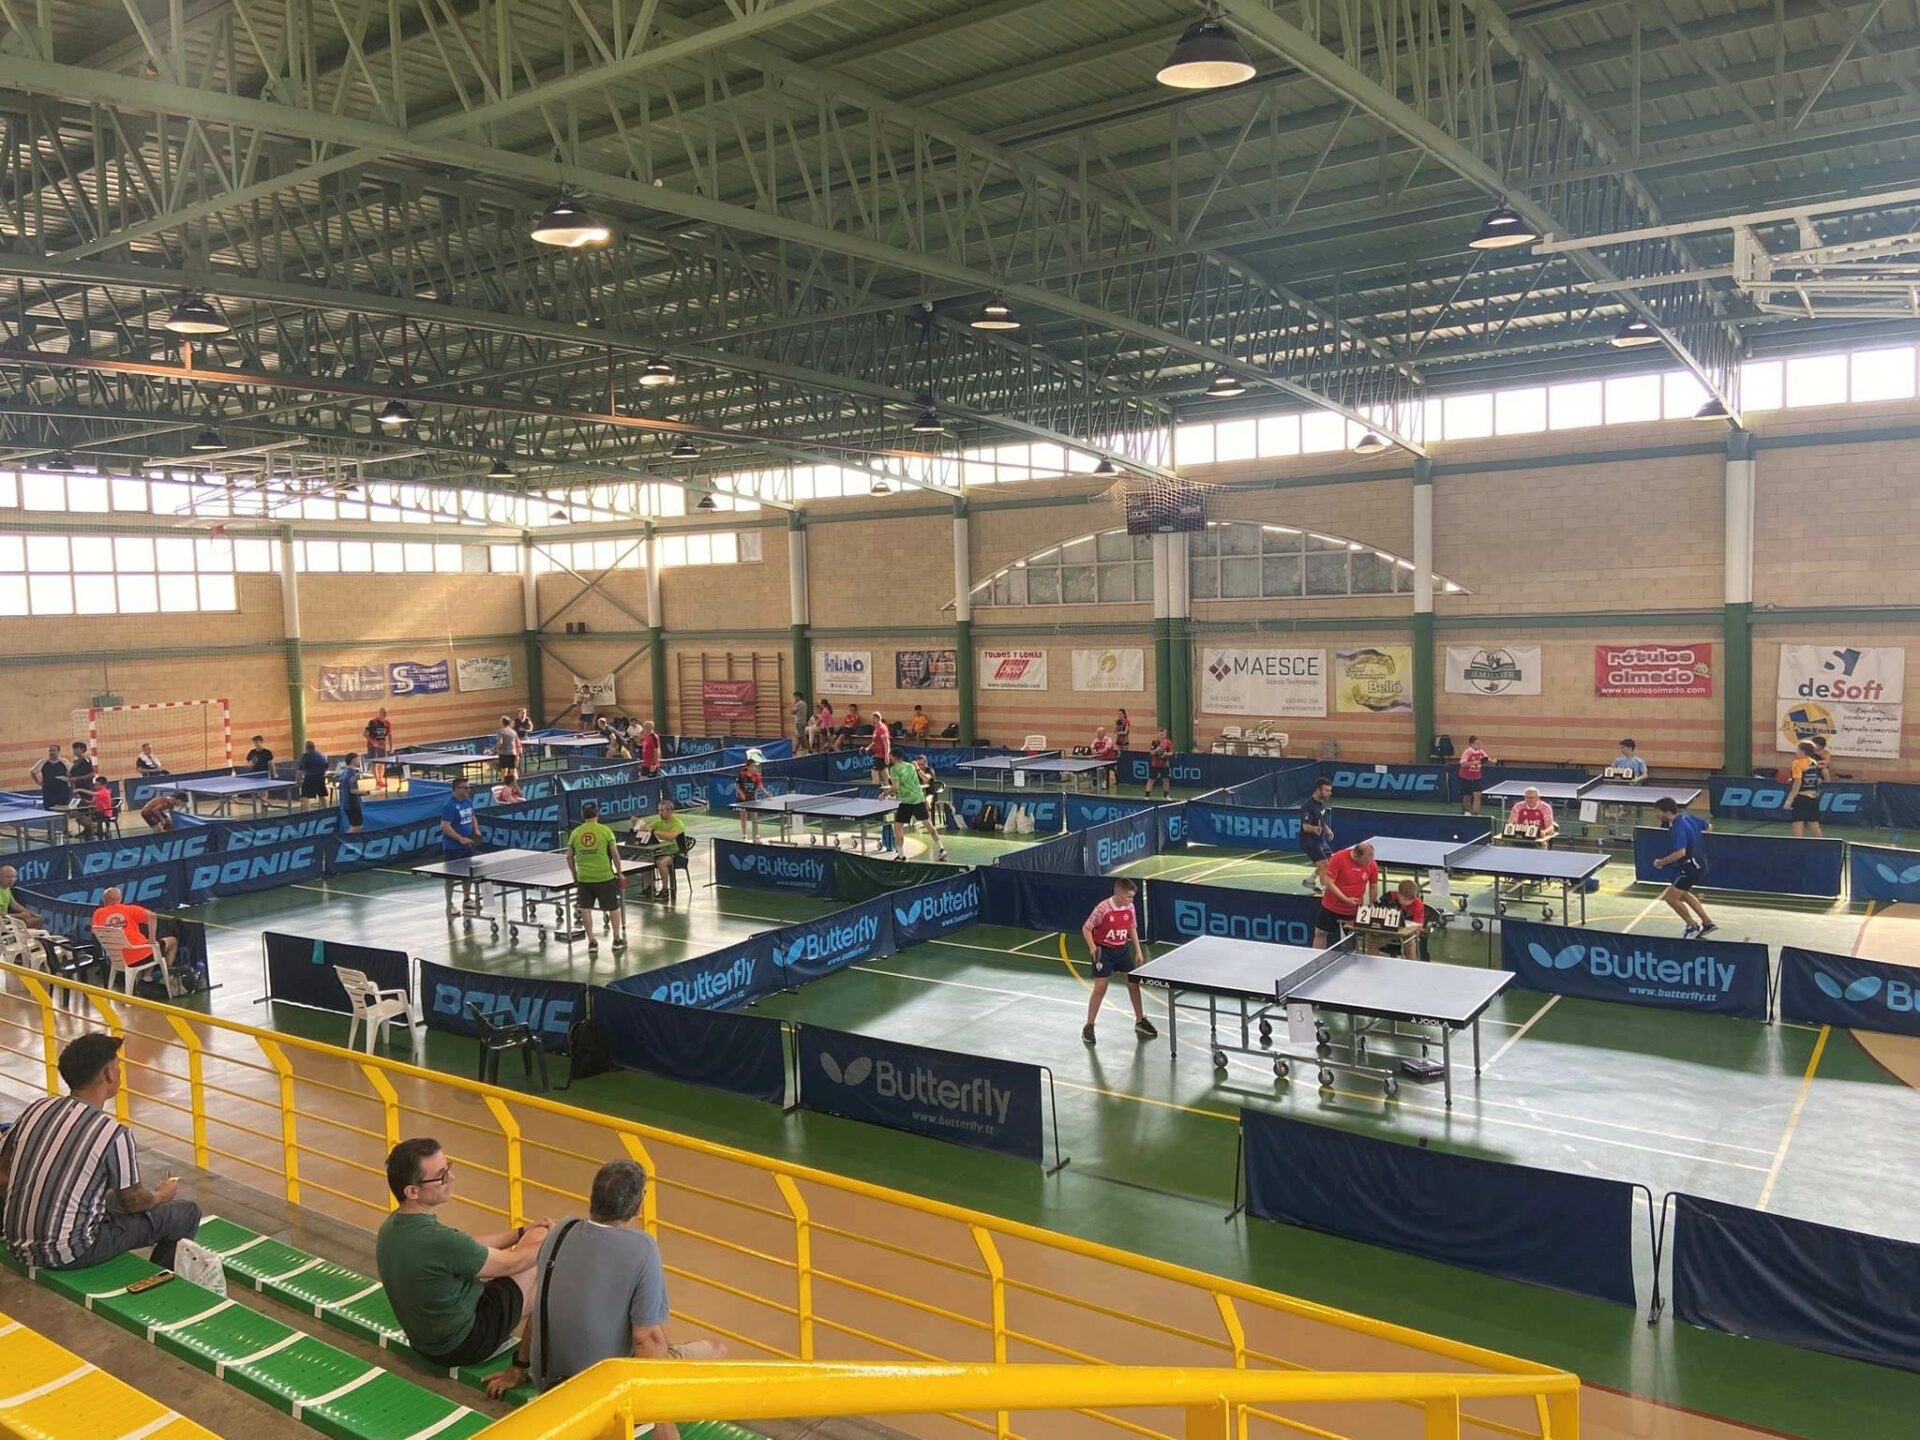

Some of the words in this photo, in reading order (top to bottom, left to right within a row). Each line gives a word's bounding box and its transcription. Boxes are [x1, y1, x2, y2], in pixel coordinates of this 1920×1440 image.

[1234, 656, 1319, 676] MAESCE
[1608, 648, 1695, 665] rótulos
[1608, 667, 1694, 685] olmedo
[1798, 677, 1883, 700] deSoft
[852, 755, 874, 768] Butte
[1172, 765, 1201, 780] dro
[1333, 771, 1438, 791] DONIC
[600, 793, 649, 816] andro
[1720, 787, 1862, 813] DOIC
[227, 816, 337, 851] DONIC
[336, 825, 443, 863] DONIC
[1110, 831, 1146, 857] andro
[83, 835, 208, 876] DONIC
[190, 845, 314, 891] DONIC
[757, 856, 824, 881] Butterfly
[923, 883, 979, 920] Butterfl
[1209, 913, 1308, 945] andro
[1360, 909, 1367, 923] 2
[1388, 912, 1398, 926] 11
[807, 915, 878, 960] Butterfly
[668, 957, 755, 1006] Butterfly
[1590, 945, 1736, 992] Butterfly
[1145, 979, 1170, 989] JOOLA
[433, 982, 575, 1033] DONIC
[1418, 1017, 1450, 1028] JOOLA
[876, 1060, 1011, 1124] Butterfly
